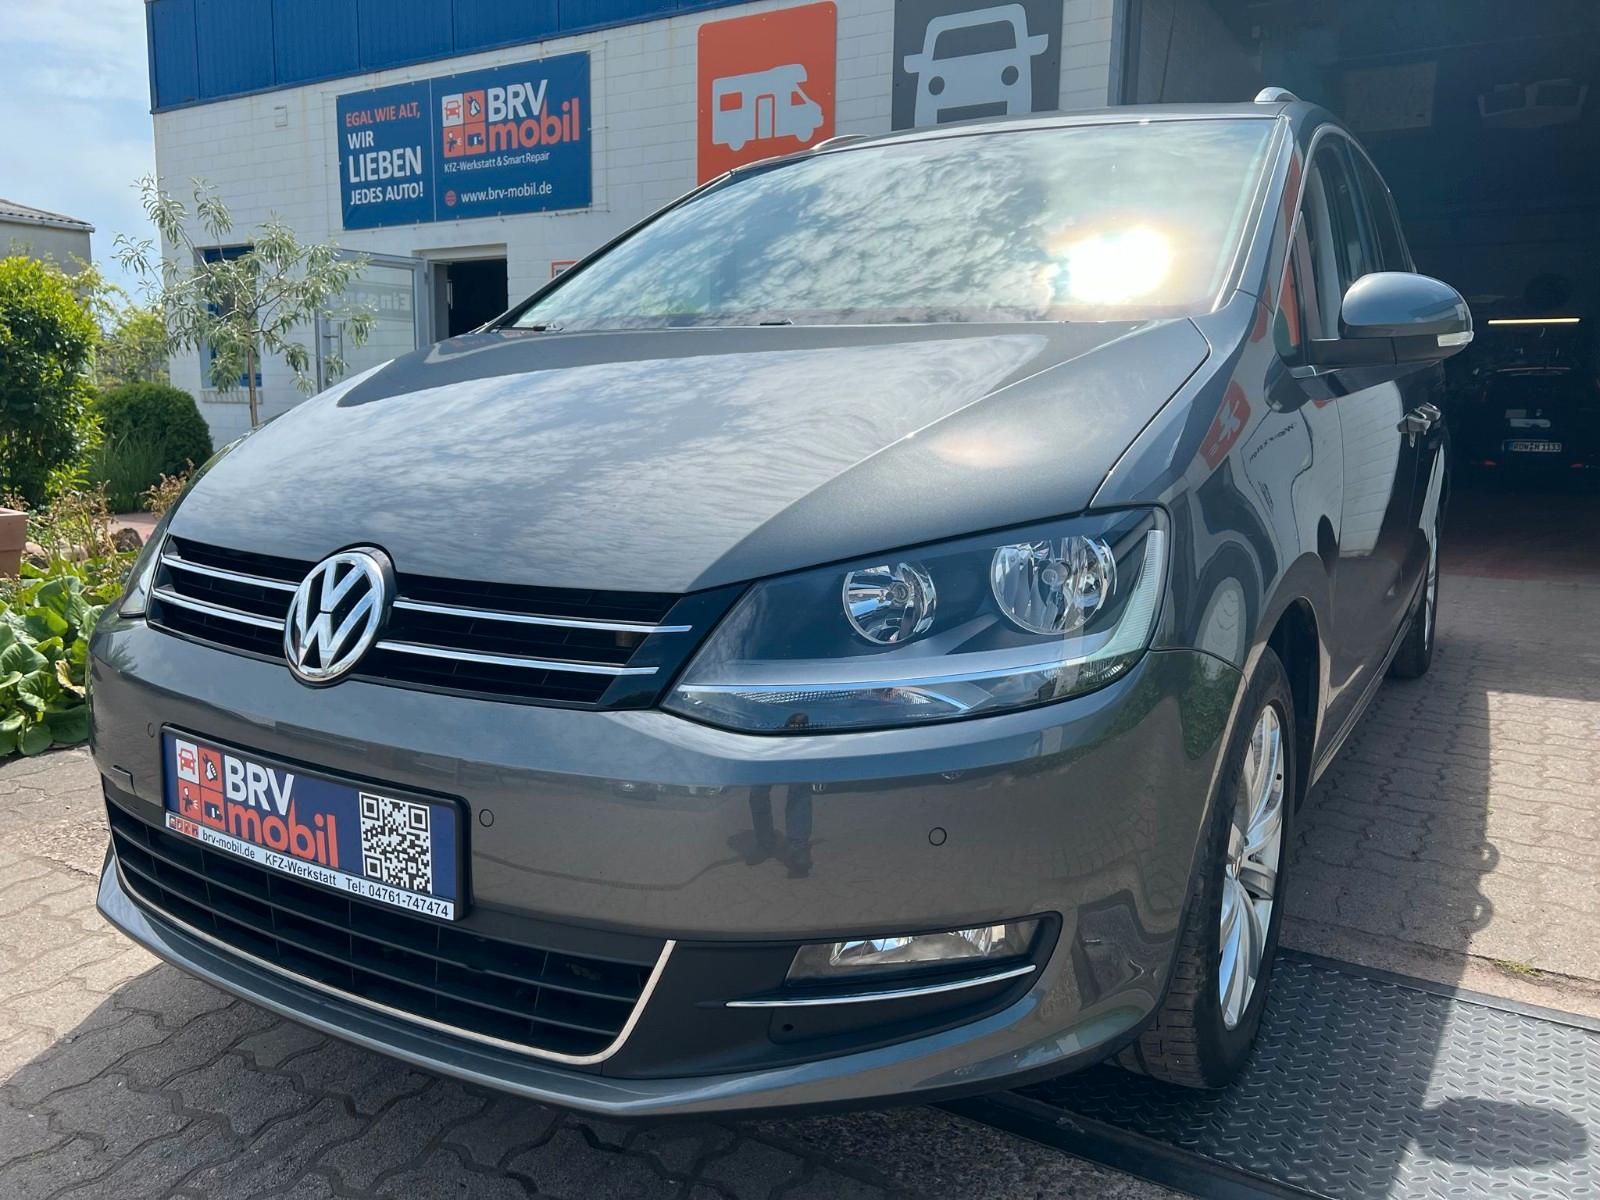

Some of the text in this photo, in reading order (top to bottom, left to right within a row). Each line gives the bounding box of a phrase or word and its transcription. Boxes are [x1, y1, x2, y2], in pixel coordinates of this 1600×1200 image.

[346, 102, 420, 127] EGAL WIE ALT,
[488, 79, 548, 122] BRV
[348, 131, 374, 149] WIR
[489, 97, 580, 152] mobil
[349, 146, 422, 183] LIEBEN
[496, 157, 502, 167] &
[503, 154, 525, 166] Smart
[525, 151, 550, 164] Repair
[350, 181, 423, 205] JEDES AUTO!
[461, 180, 552, 203] www.brv-mobil.de
[224, 754, 294, 816] BRV
[227, 799, 339, 868] mobil
[202, 830, 449, 917] brv-mobil.de KFZ-Werkstatt Tel: 04761-747474
